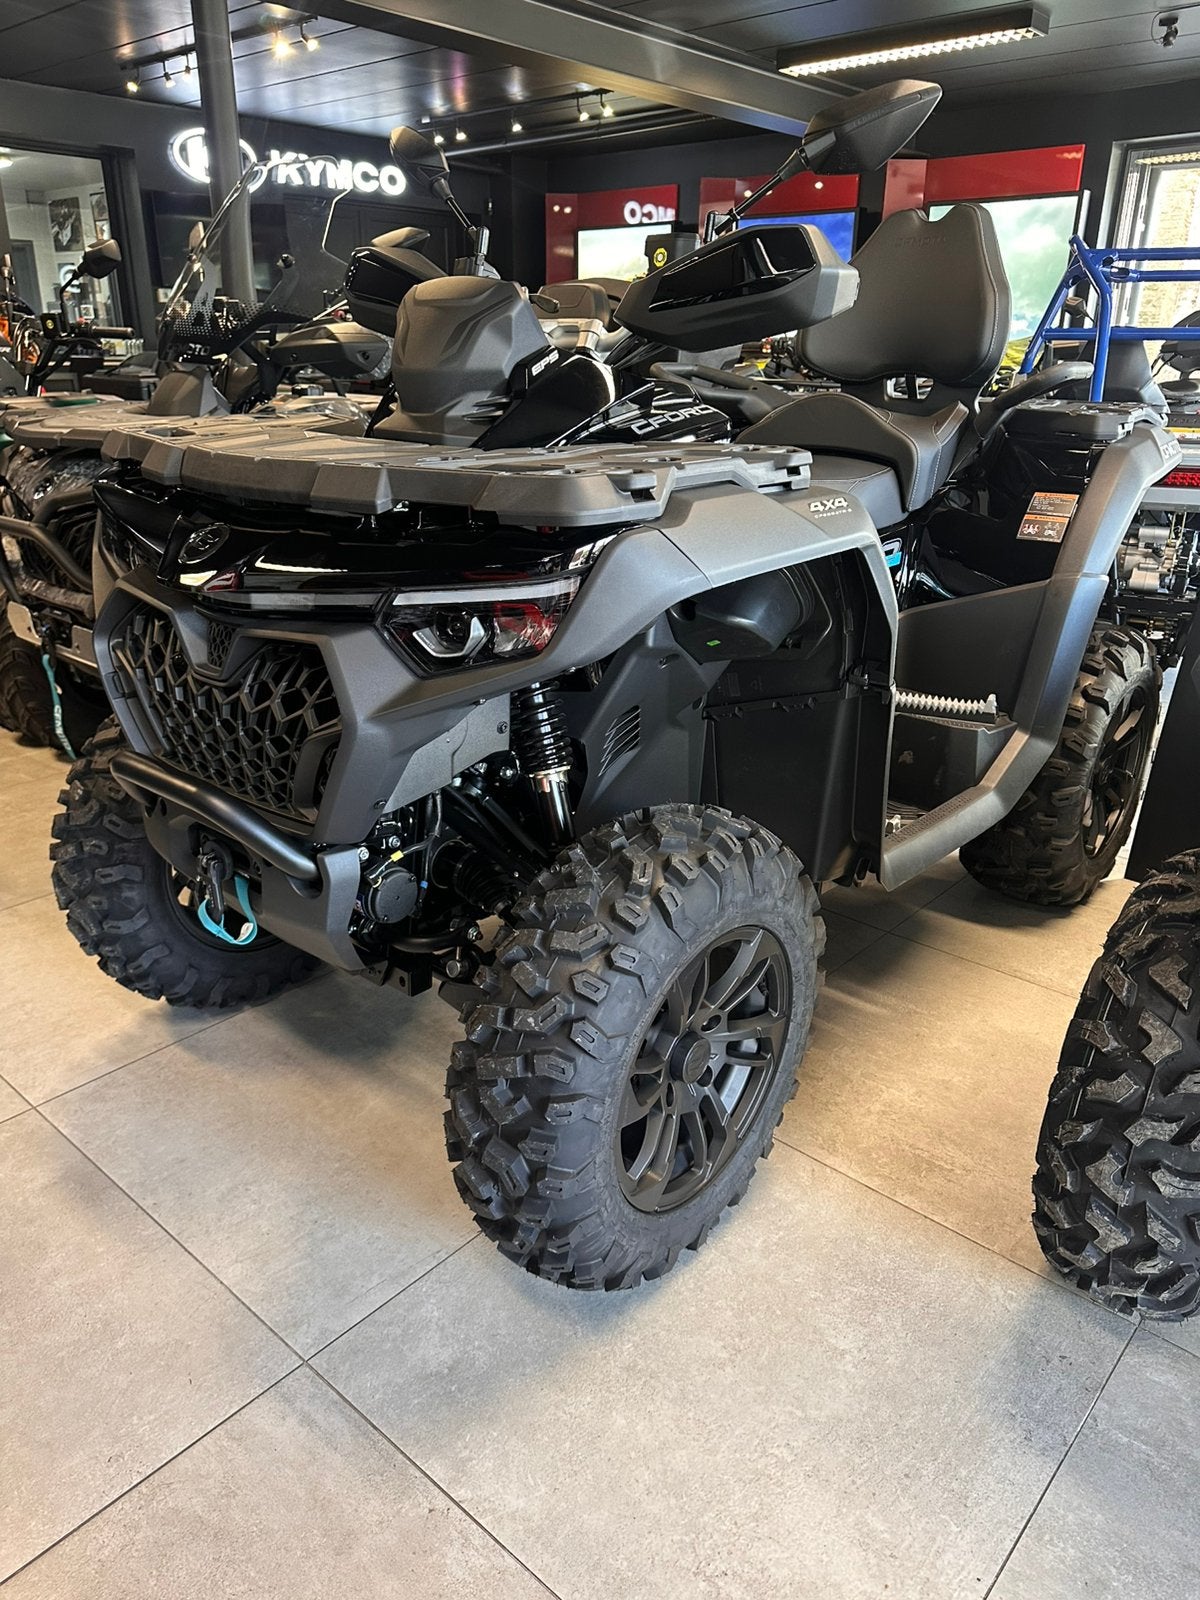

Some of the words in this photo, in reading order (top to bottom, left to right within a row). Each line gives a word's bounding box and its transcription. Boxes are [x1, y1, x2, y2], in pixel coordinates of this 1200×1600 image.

[270, 149, 407, 196] KYMCO
[531, 349, 560, 377] EPS
[809, 497, 849, 512] 4X4
